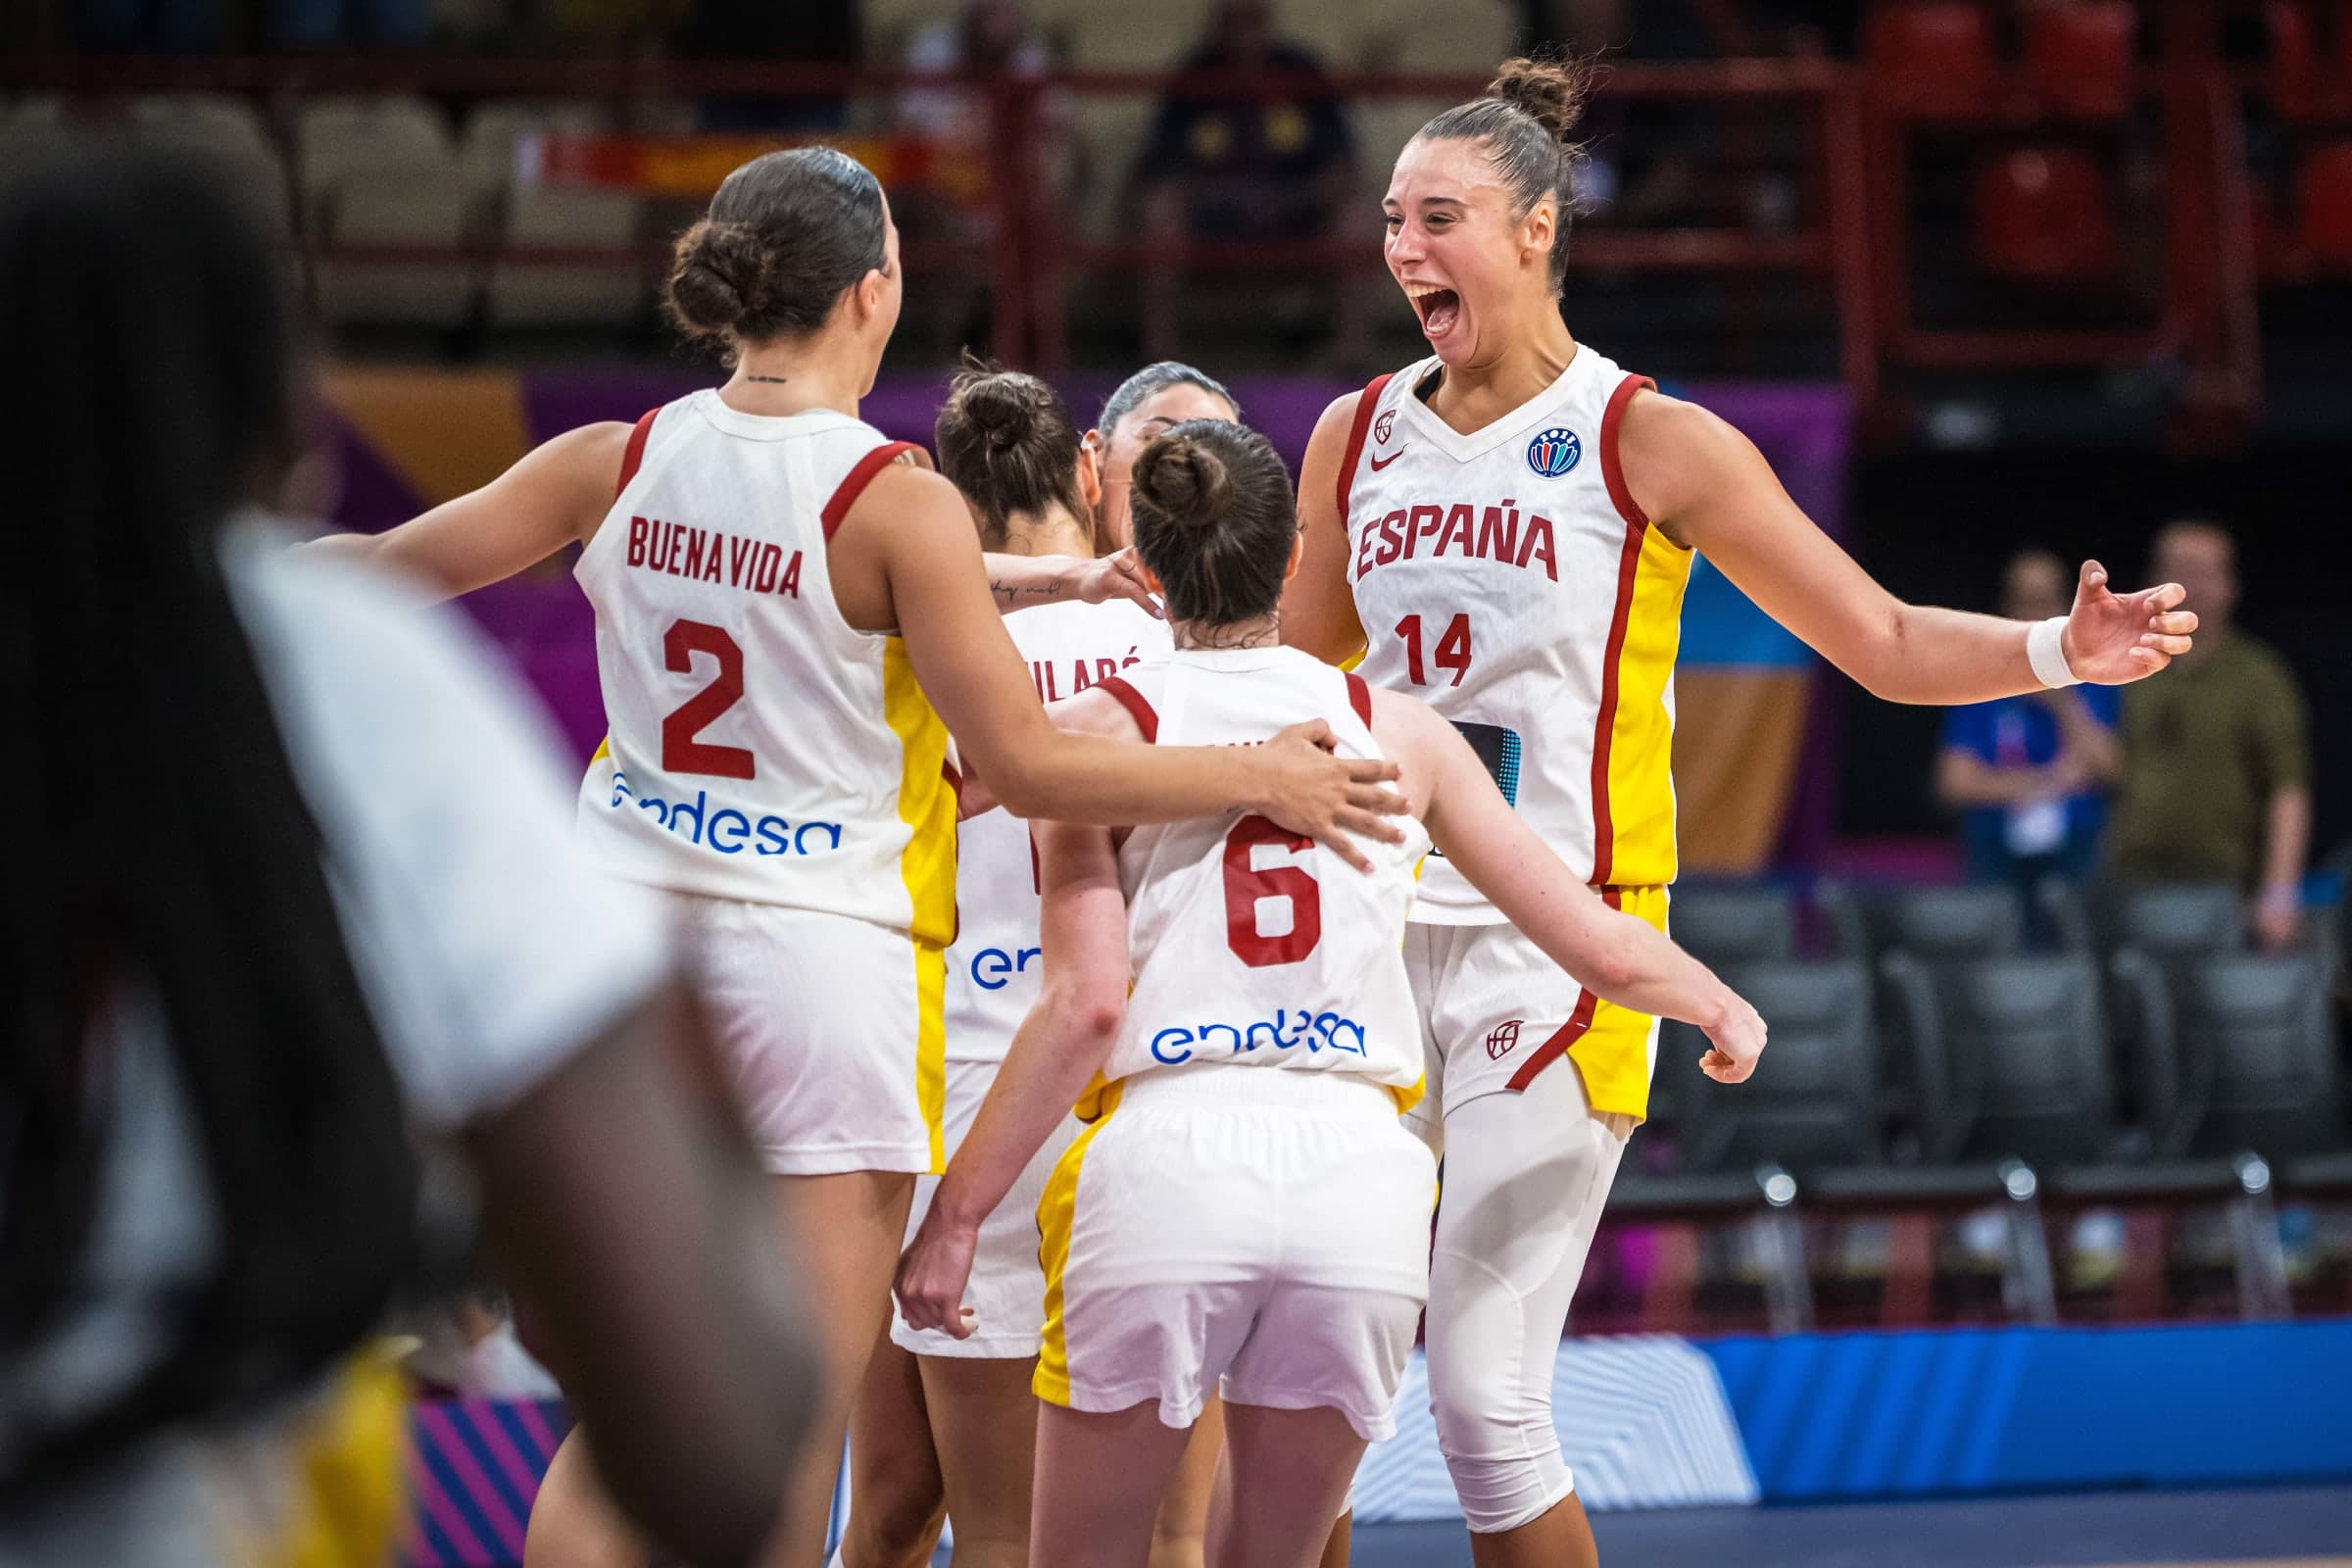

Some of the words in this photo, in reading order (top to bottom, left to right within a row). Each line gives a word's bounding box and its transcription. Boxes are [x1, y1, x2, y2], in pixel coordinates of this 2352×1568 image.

[626, 515, 804, 600] BUENAVIDA
[1356, 498, 1559, 583] ESPAÑA
[1394, 612, 1473, 688] 14
[662, 617, 755, 781] 2
[1222, 814, 1322, 968] 6
[1151, 1008, 1367, 1065] endesa
